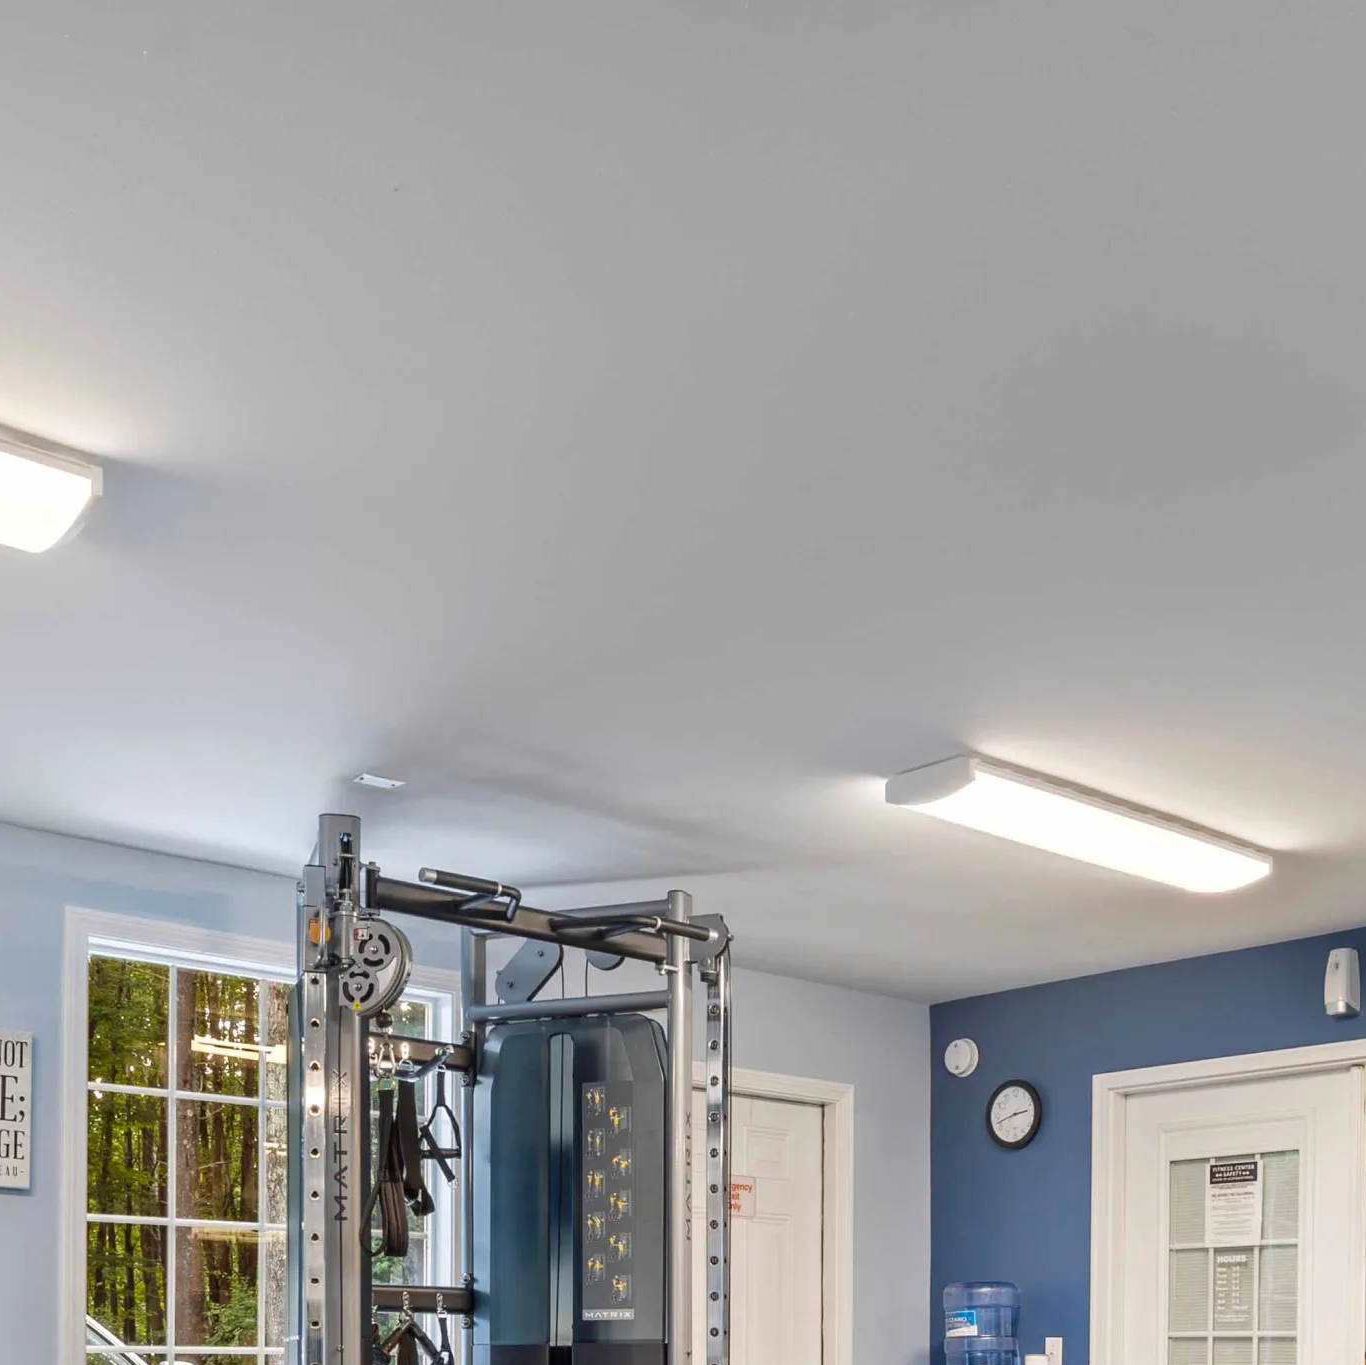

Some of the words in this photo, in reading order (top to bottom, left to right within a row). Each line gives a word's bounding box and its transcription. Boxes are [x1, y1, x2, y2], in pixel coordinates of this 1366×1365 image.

[333, 1068, 348, 1222] MATRIX
[1212, 1165, 1234, 1173] FITNESS
[1216, 1255, 1247, 1263] HOURS
[584, 1311, 633, 1319] MATRIX
